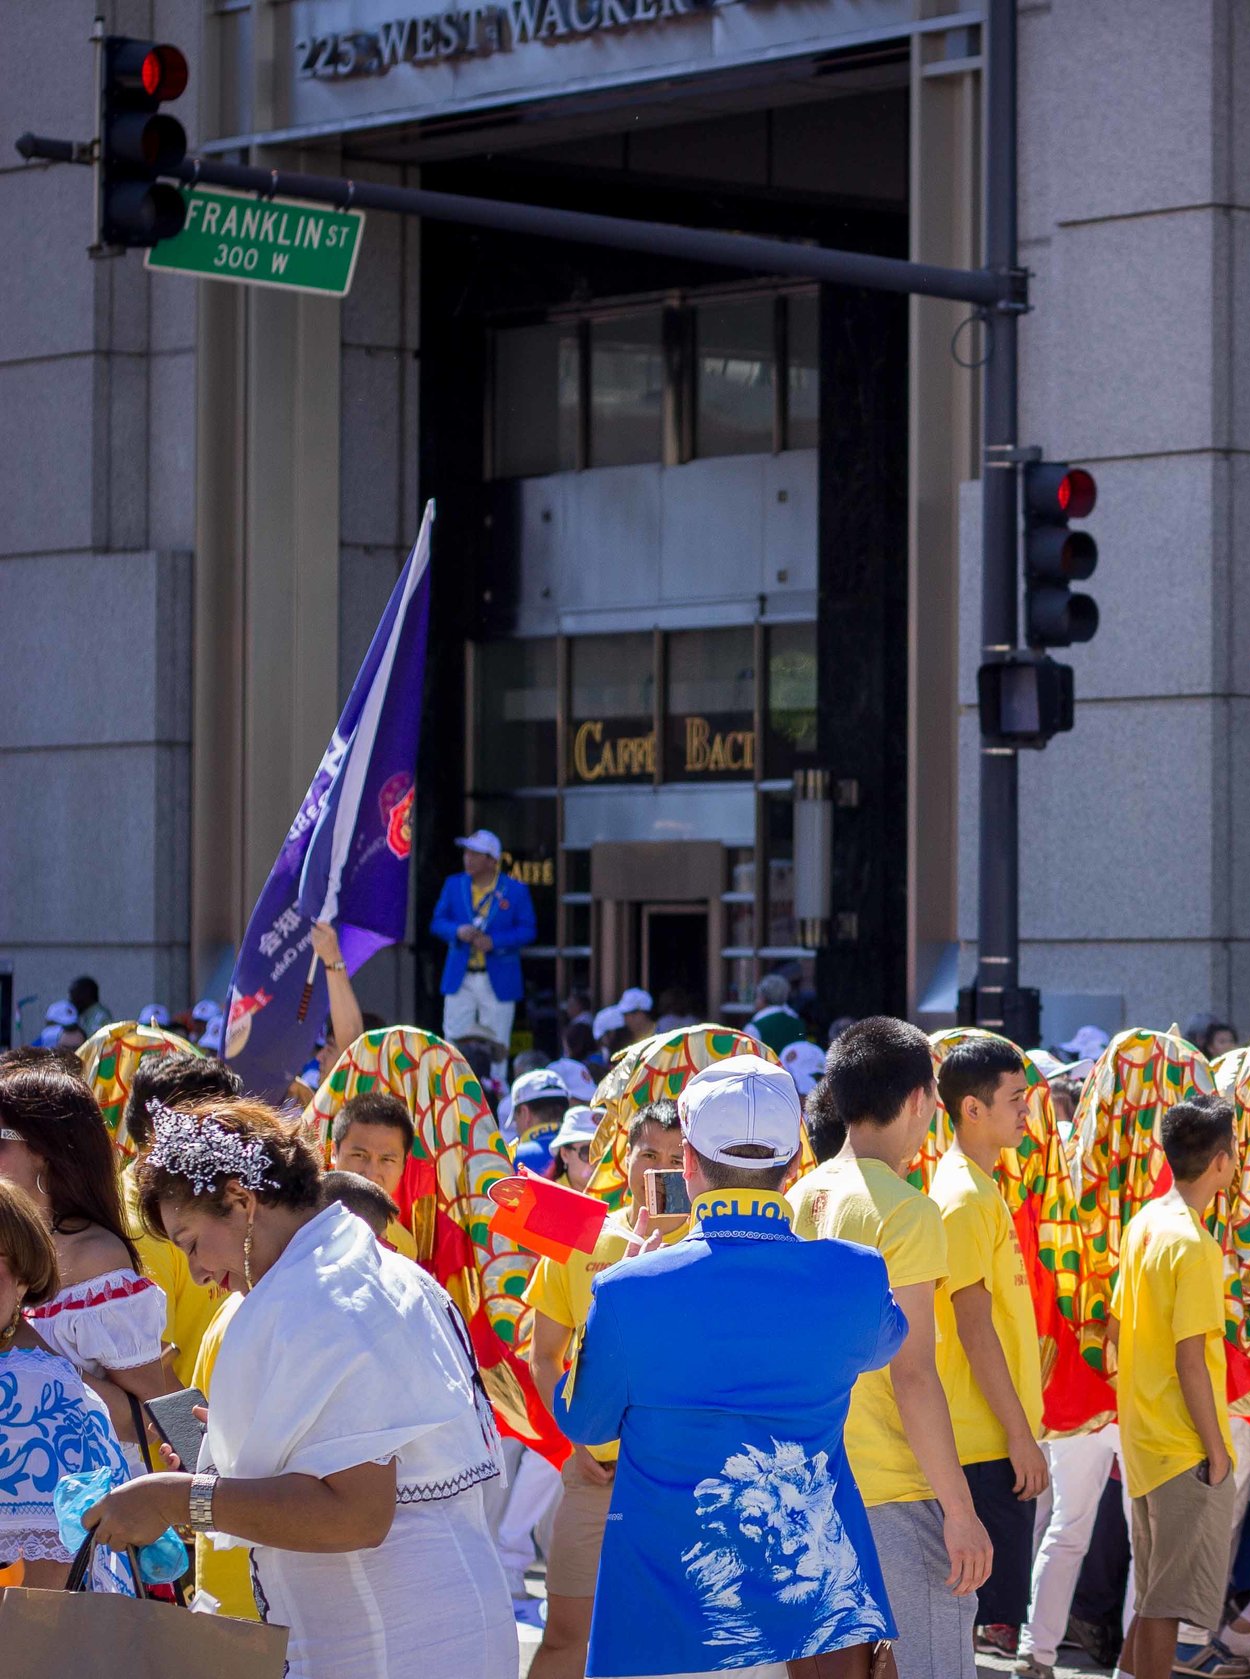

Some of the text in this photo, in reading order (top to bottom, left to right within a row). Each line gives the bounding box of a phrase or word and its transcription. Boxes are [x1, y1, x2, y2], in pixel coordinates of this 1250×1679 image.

[296, 33, 358, 76] 225
[377, 8, 486, 66] WEST
[183, 198, 349, 249] FRANKLIN ST
[213, 243, 289, 275] 300 W
